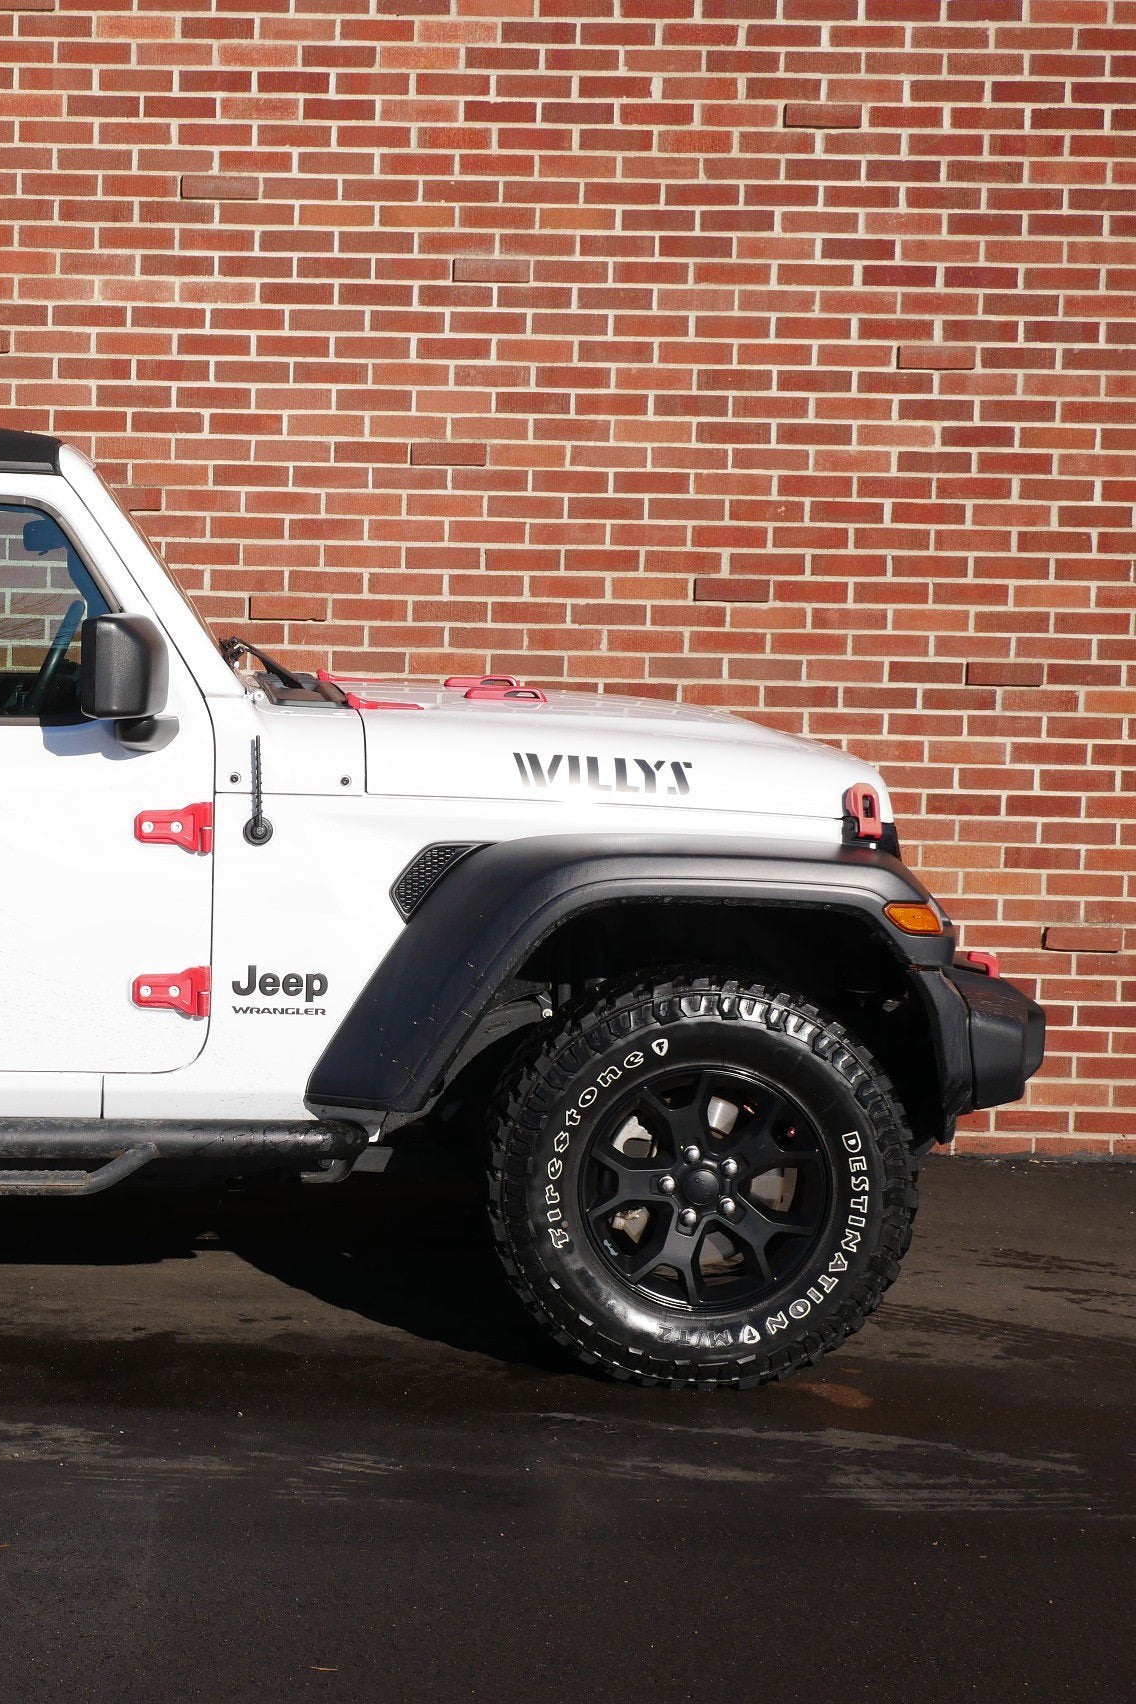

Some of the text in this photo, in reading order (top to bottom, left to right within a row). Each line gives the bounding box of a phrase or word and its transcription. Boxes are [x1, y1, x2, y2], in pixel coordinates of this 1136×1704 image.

[512, 751, 693, 796] WILLYS
[231, 964, 329, 1003] Jeep
[231, 1004, 327, 1016] WRANGLER
[544, 1050, 645, 1250] Firestone
[765, 1130, 870, 1335] DESTINATION
